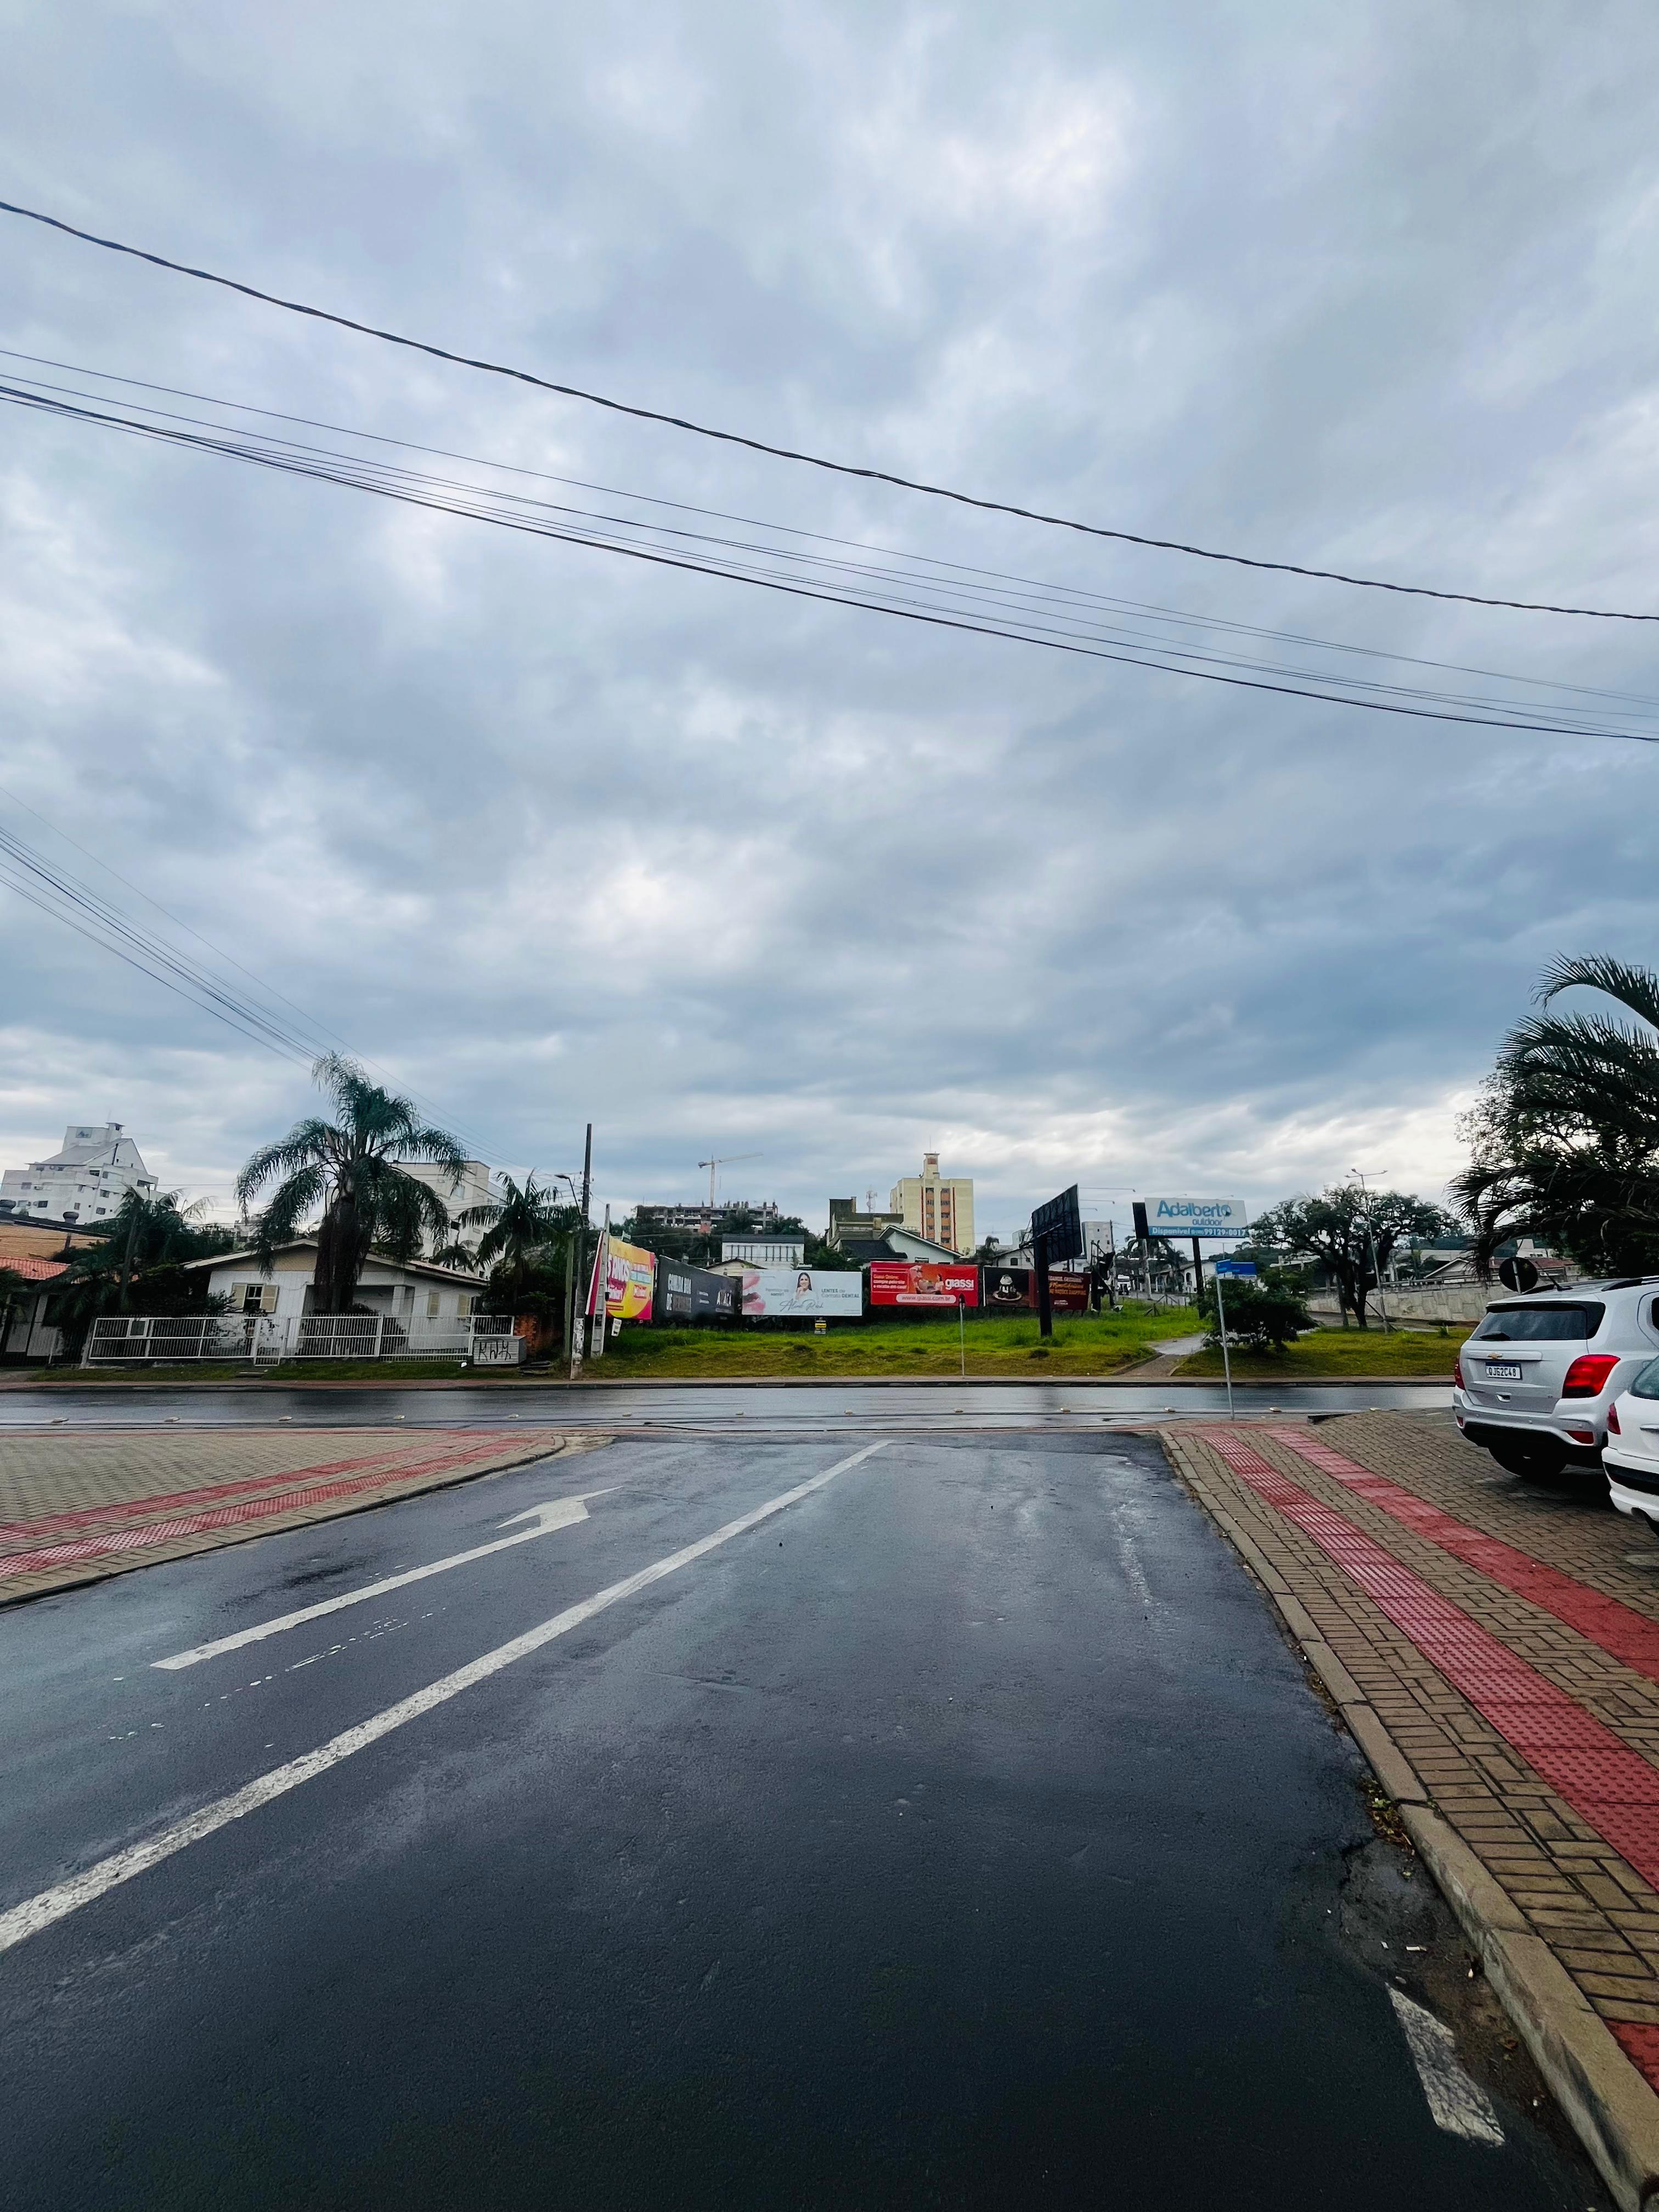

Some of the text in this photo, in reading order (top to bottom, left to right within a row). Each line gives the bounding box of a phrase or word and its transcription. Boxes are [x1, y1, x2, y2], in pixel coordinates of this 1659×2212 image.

[1156, 1200, 1232, 1217] Adalberto
[1192, 1217, 1222, 1226] outdoor
[945, 1278, 974, 1290] giassi
